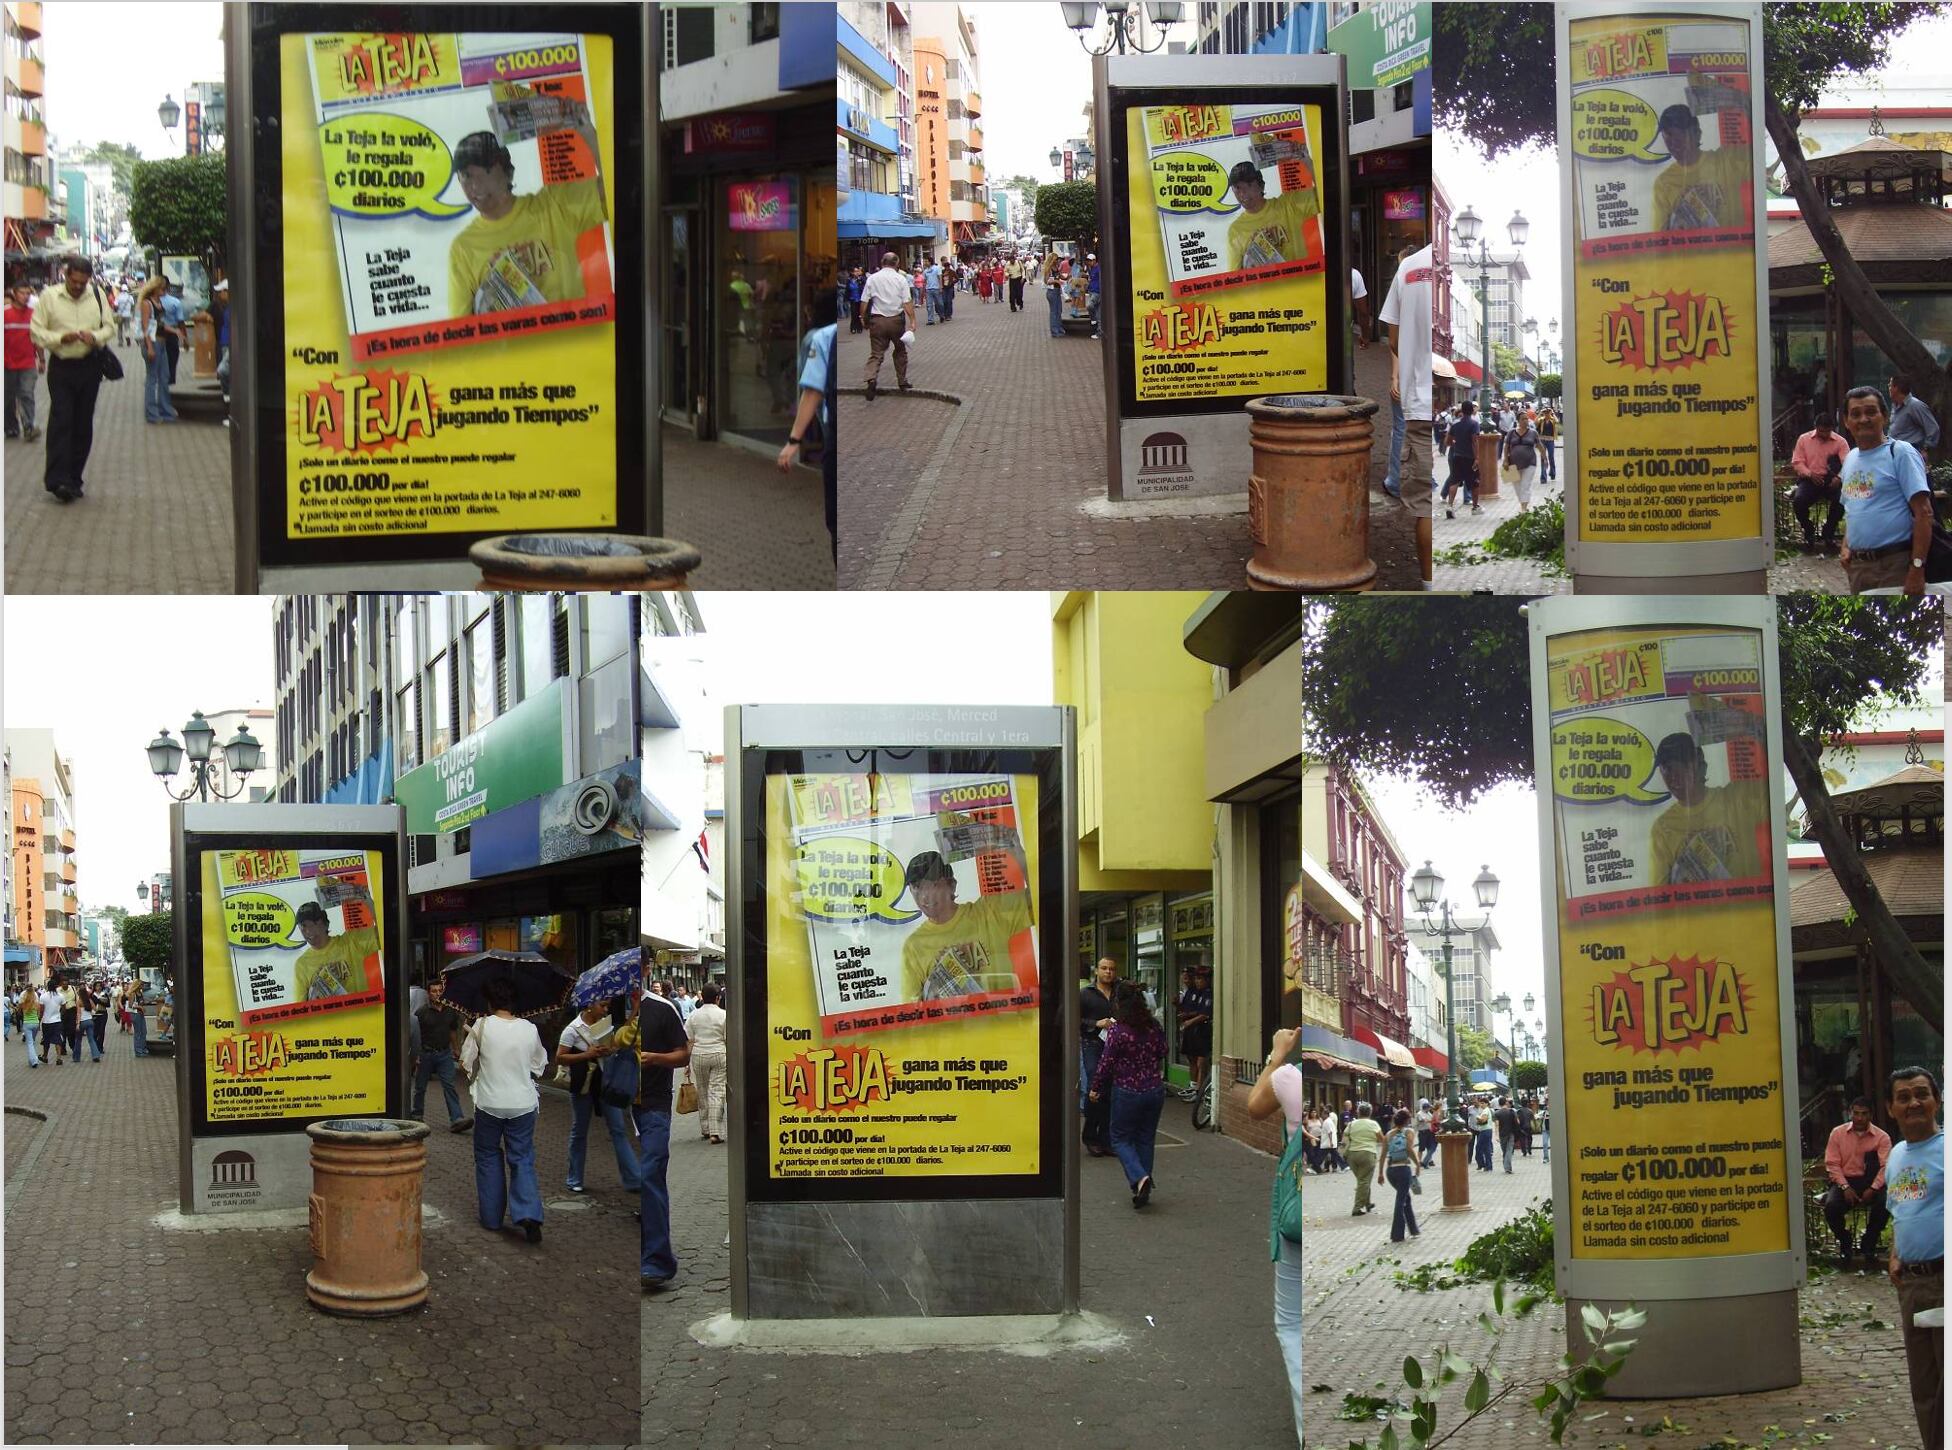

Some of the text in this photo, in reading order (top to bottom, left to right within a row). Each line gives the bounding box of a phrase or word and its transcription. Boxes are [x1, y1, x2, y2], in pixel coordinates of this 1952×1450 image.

[1384, 14, 1416, 53] INFO
[918, 90, 939, 98] HOTEL
[325, 129, 436, 150] La Teja la voló,
[347, 150, 413, 168] le regala
[929, 120, 937, 216] BALMORAL
[352, 194, 406, 208] diarios
[1229, 308, 1303, 322] gana más que
[1142, 304, 1221, 349] LA TEJA
[1221, 324, 1264, 336] jugando
[1602, 297, 1730, 367] LA TEJA
[1143, 363, 1195, 375] ¢100.000
[450, 382, 576, 404] gana más que
[1592, 381, 1700, 399] gana más que
[298, 375, 435, 449] LA TEJA
[1617, 400, 1681, 417] jugando
[437, 409, 509, 429] jugando
[300, 474, 389, 494] ¢100.000
[1137, 476, 1194, 485] MUNICIPALIDAD
[1142, 485, 1151, 493] DE
[1589, 510, 1596, 519] el
[1598, 509, 1626, 519] sorteo
[1628, 509, 1639, 519] de
[1688, 507, 1721, 517] diarios.
[1589, 520, 1711, 531] Llamada sin costo adicional
[948, 709, 998, 722] Merced
[934, 728, 983, 743] Central
[988, 731, 996, 744] y
[1002, 729, 1029, 743] 1era
[1554, 733, 1641, 748] La Teja la voló,
[434, 730, 486, 781] TOURIST
[1569, 749, 1622, 762] le regala
[446, 767, 474, 802] INFO
[1572, 783, 1615, 795] diarios
[16, 826, 36, 834] HOTEL
[834, 946, 870, 960] La Teja
[836, 959, 862, 970] sabe
[837, 968, 874, 981] cuanto
[839, 976, 888, 992] le cuesta
[840, 988, 886, 1002] la vida...
[1593, 962, 1747, 1049] LA TEJA
[295, 1036, 363, 1048] gana más que
[213, 1032, 287, 1074] LA TEJA
[288, 1051, 328, 1062] jugando
[903, 1057, 1007, 1074] gana más que
[778, 1048, 890, 1109] LA TEJA
[1583, 1065, 1713, 1089] gana más que
[214, 1087, 262, 1098] ¢100.000
[891, 1078, 952, 1094] jugando
[1614, 1086, 1690, 1109] jugando
[779, 1115, 799, 1125] ¡Solo
[814, 1115, 836, 1123] diario
[871, 1115, 901, 1123] nuestro
[903, 1115, 927, 1125] puede
[929, 1114, 957, 1124] regalar
[779, 1129, 853, 1145] ¢100.000
[779, 1147, 803, 1155] Active
[814, 1146, 838, 1156] código
[840, 1147, 853, 1156] que
[856, 1145, 875, 1154] viene
[889, 1145, 895, 1153] la
[898, 1145, 928, 1155] portada
[951, 1145, 965, 1154] Teja
[968, 1144, 974, 1152] al
[976, 1144, 1011, 1153] 247-6060
[208, 1191, 261, 1199] MUNICIPALIDAD
